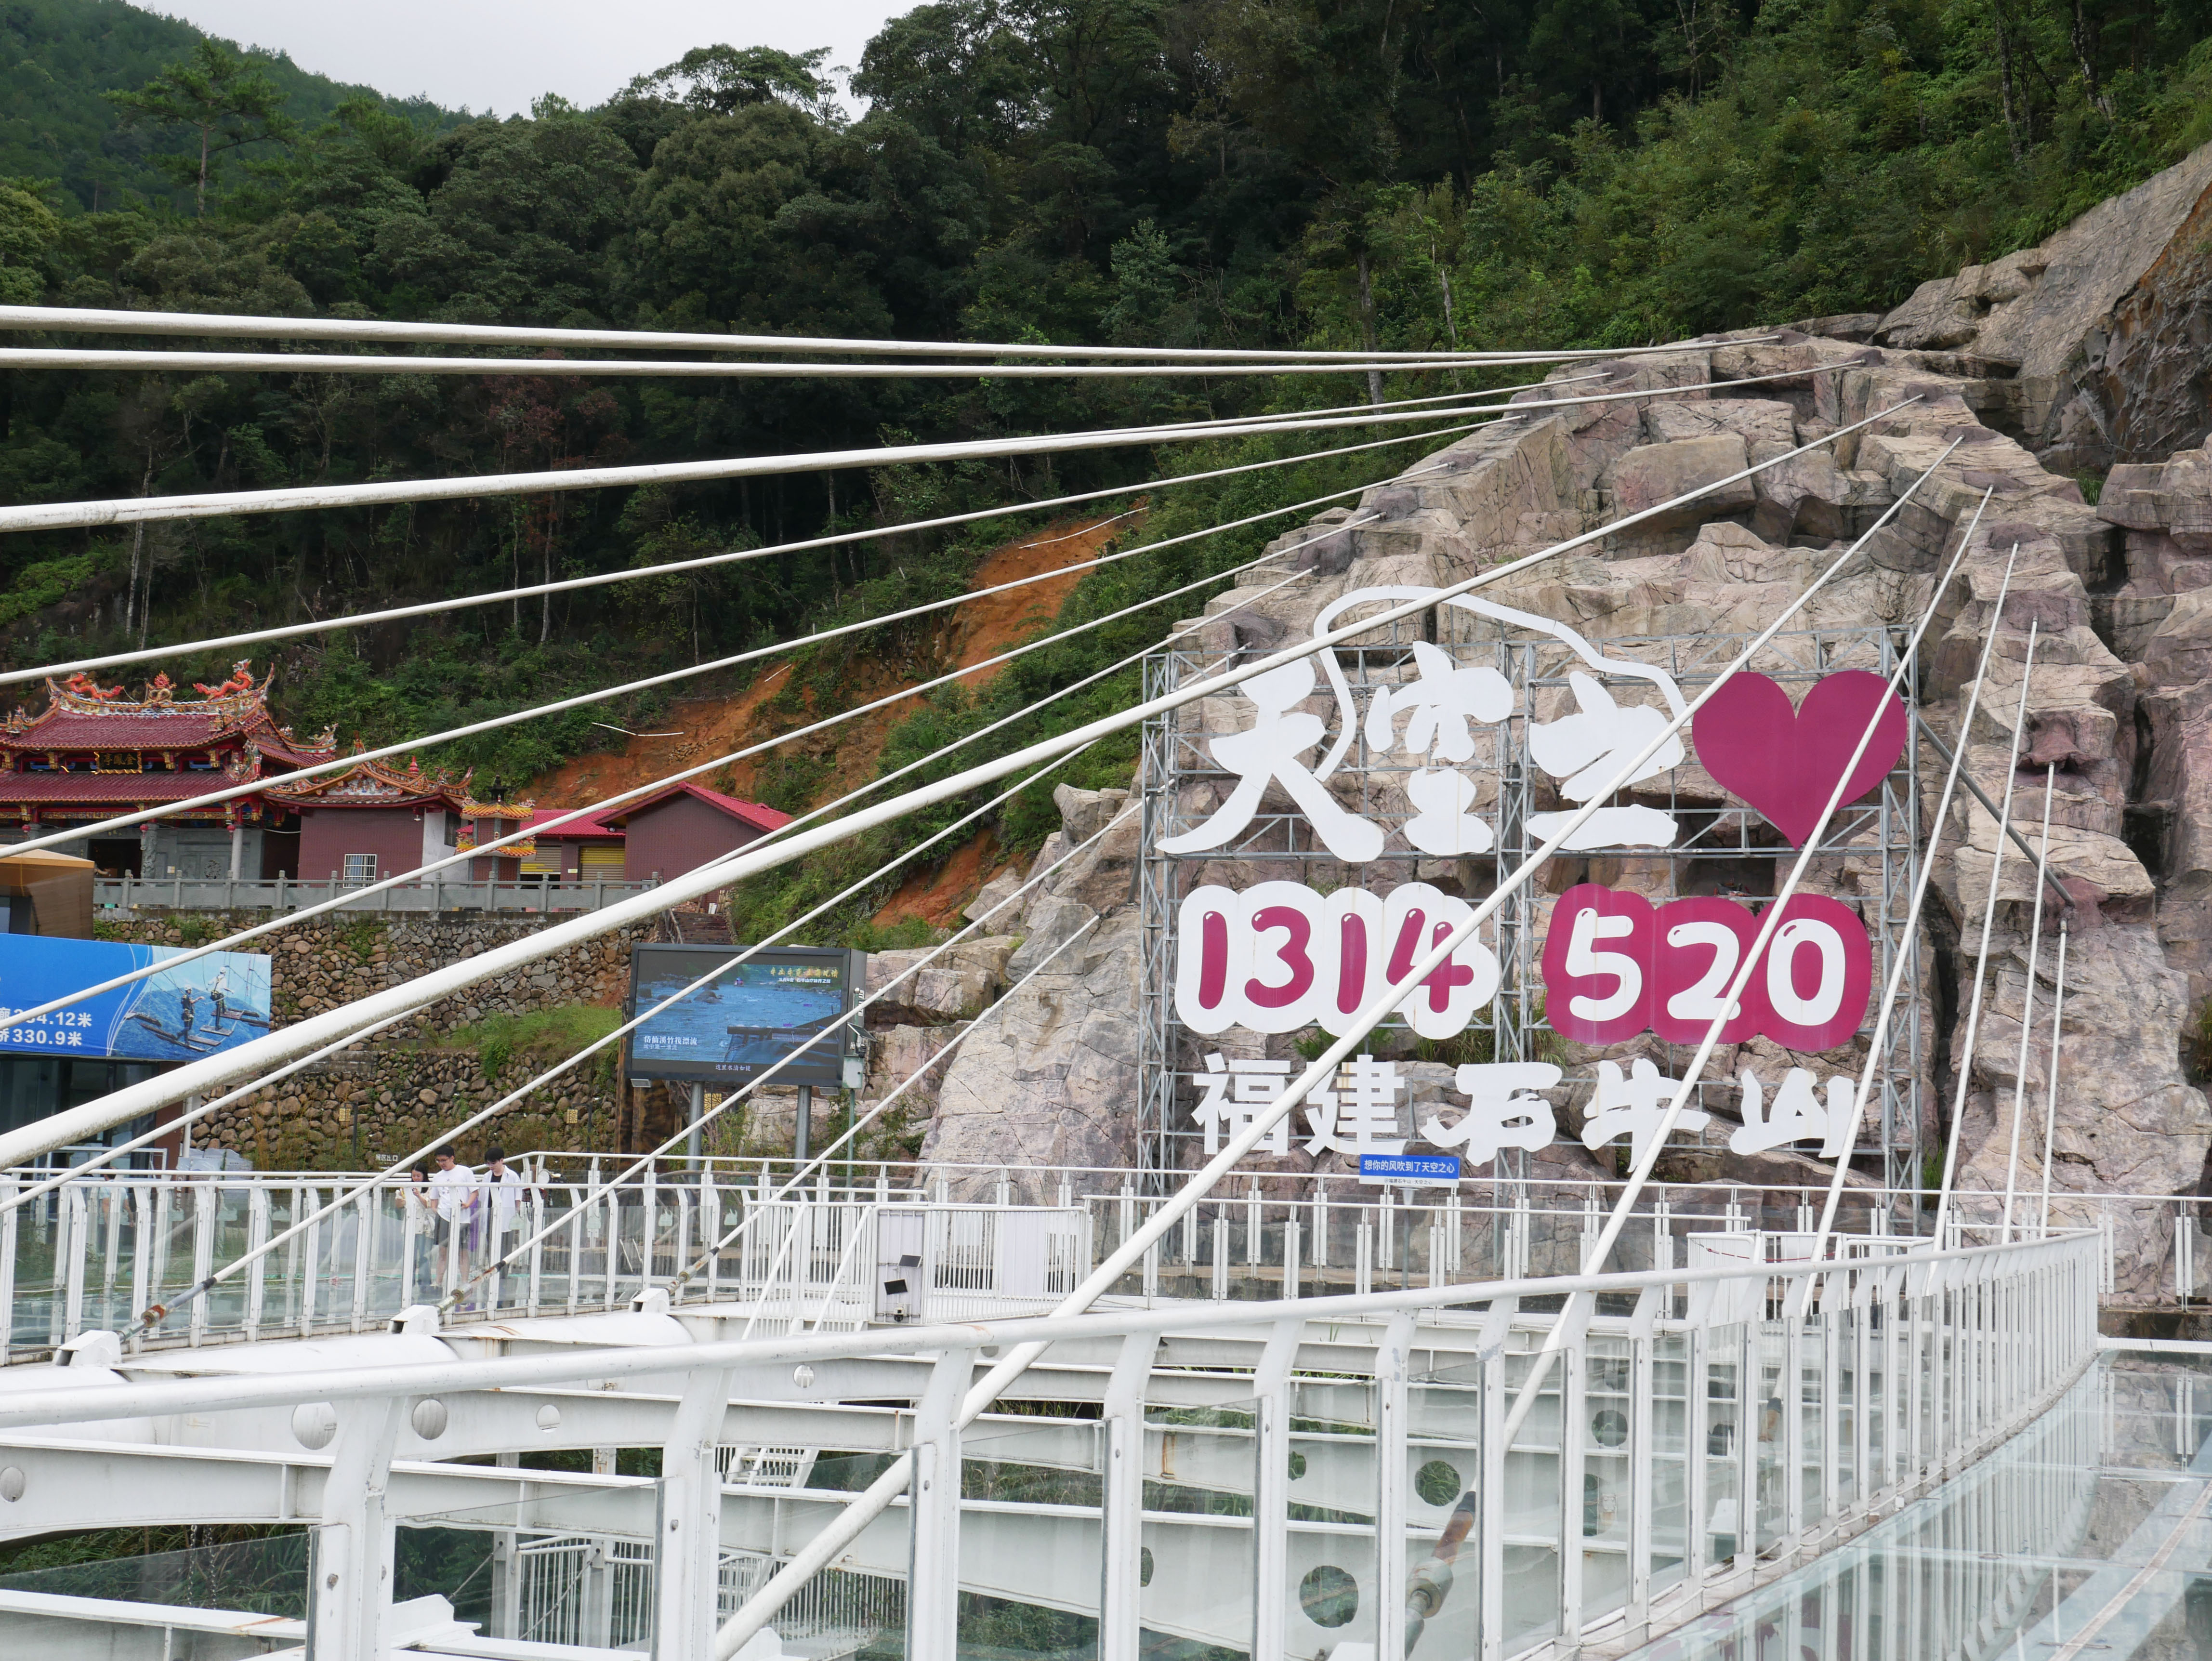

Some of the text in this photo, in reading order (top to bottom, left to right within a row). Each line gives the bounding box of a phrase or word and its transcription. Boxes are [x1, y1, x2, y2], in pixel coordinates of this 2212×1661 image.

[1198, 906, 1846, 1026] 1314 520
[1364, 1160, 1455, 1173] 想你的风吹到了天空之心
